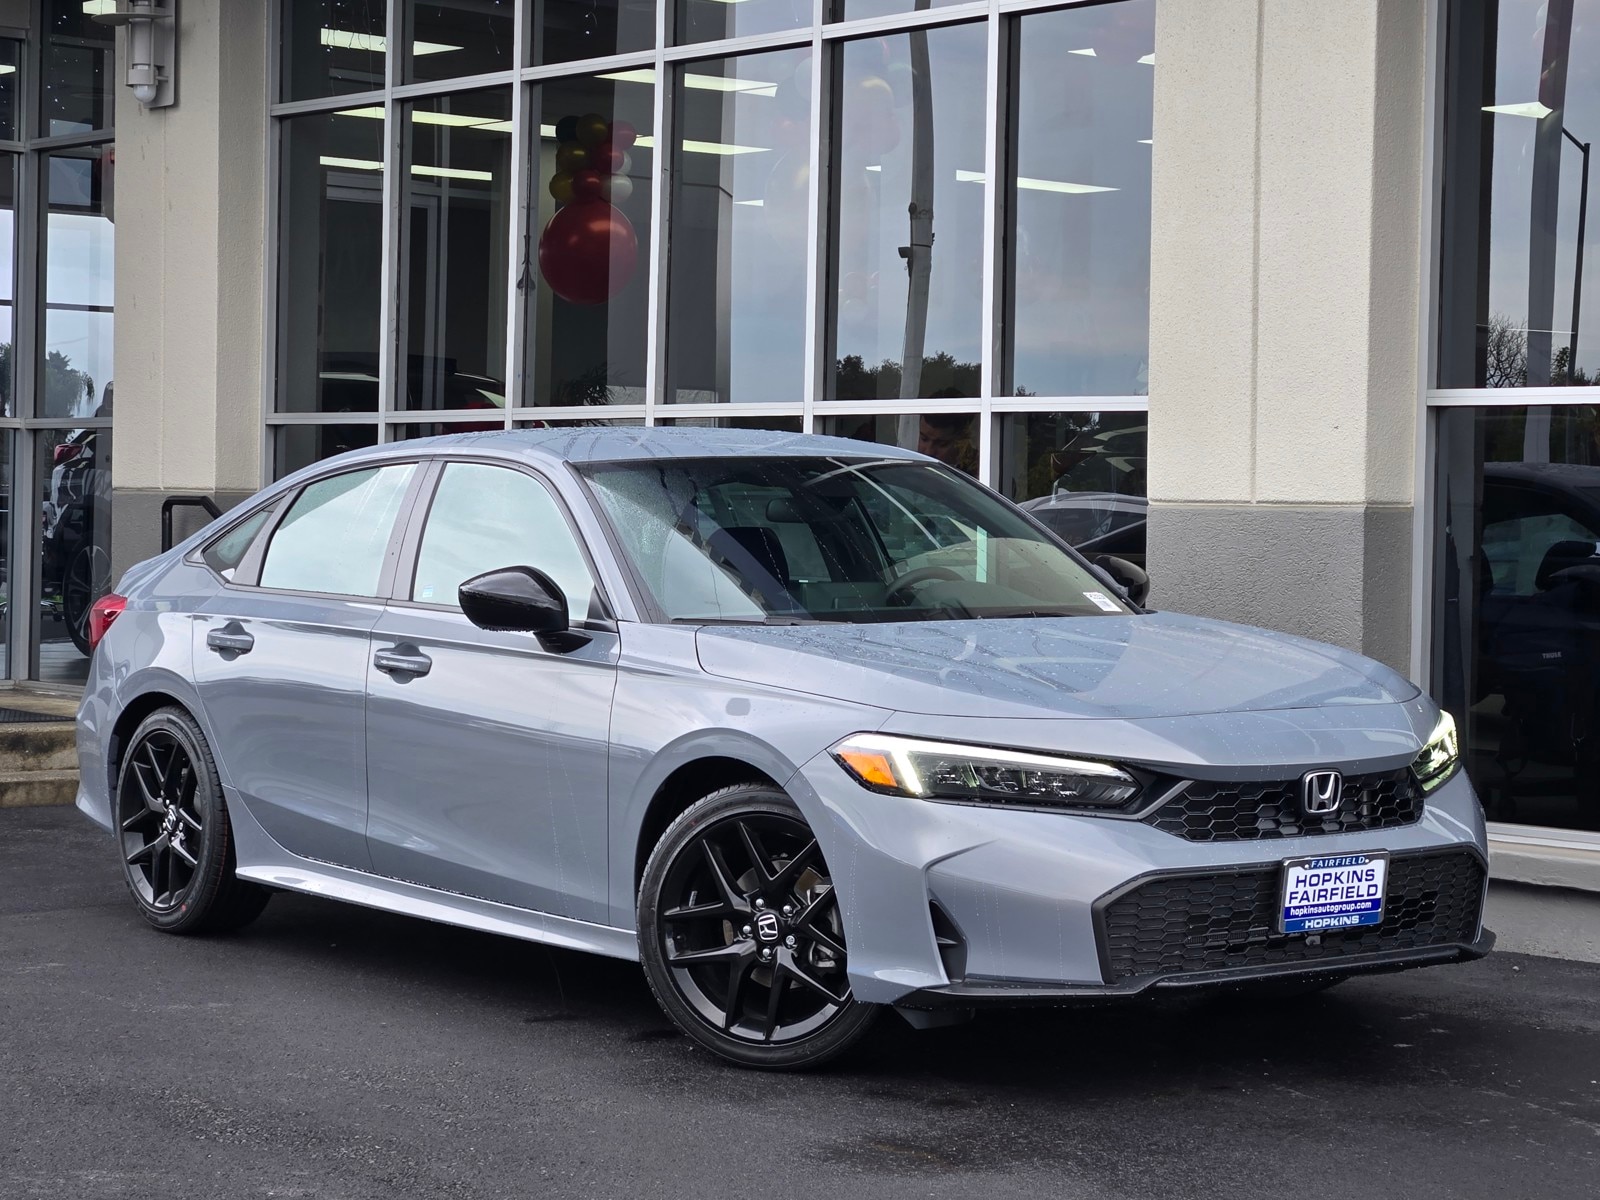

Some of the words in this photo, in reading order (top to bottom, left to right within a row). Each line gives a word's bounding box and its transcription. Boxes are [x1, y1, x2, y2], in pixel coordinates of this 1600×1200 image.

[1311, 856, 1365, 869] FAIRFIELD
[1295, 868, 1376, 888] HOPKINS
[1288, 884, 1379, 905] FAIRFIELD
[1290, 901, 1372, 917] hopkinsautogroup.com
[1304, 915, 1360, 929] HOPKINS
